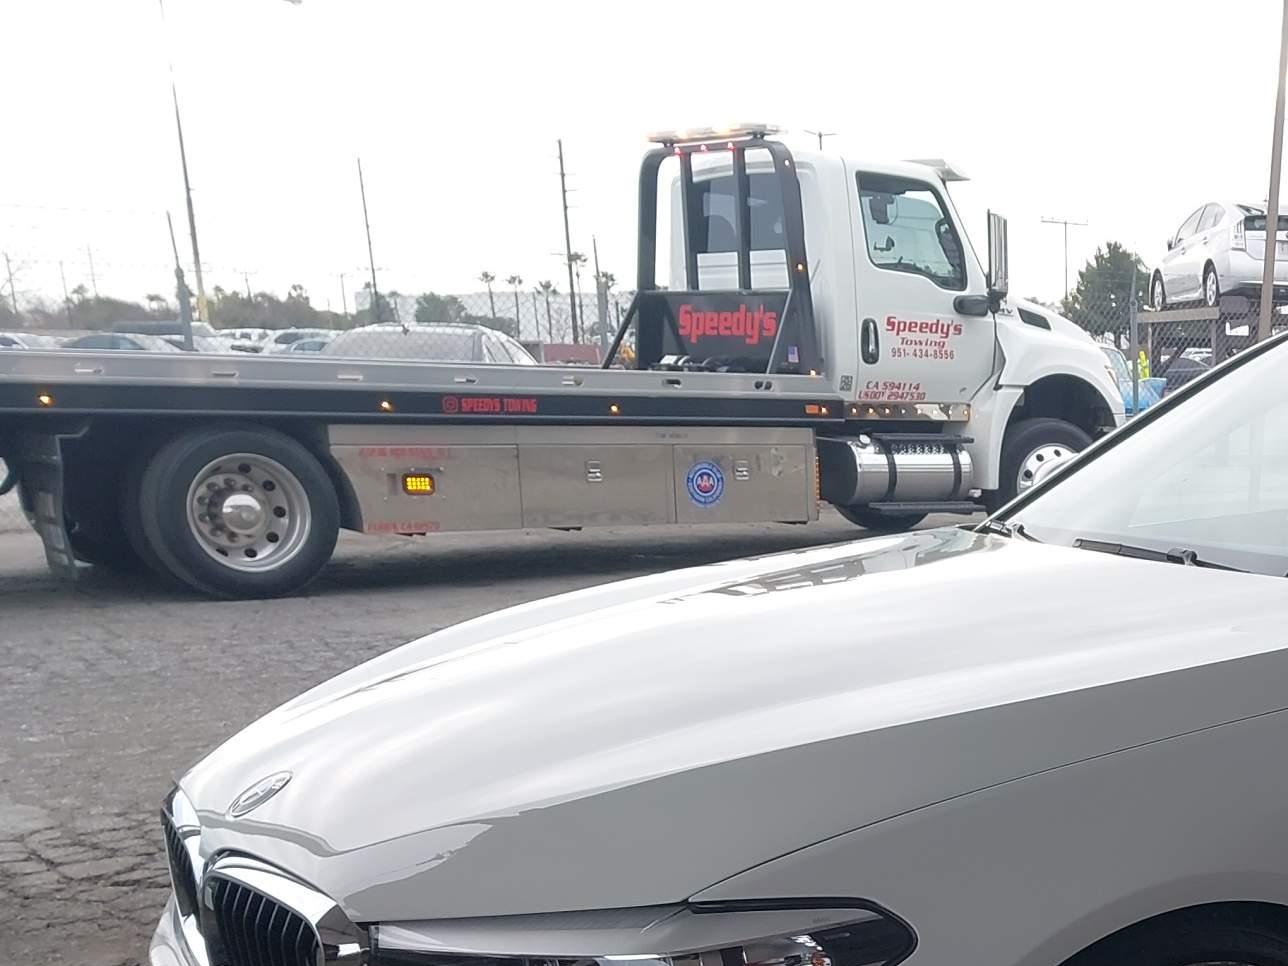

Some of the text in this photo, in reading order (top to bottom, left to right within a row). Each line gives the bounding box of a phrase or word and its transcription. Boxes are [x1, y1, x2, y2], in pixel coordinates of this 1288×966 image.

[678, 303, 777, 345] Speedy's
[885, 316, 963, 338] Speedy's
[899, 336, 947, 349] Towing
[866, 381, 921, 391] CA 594114
